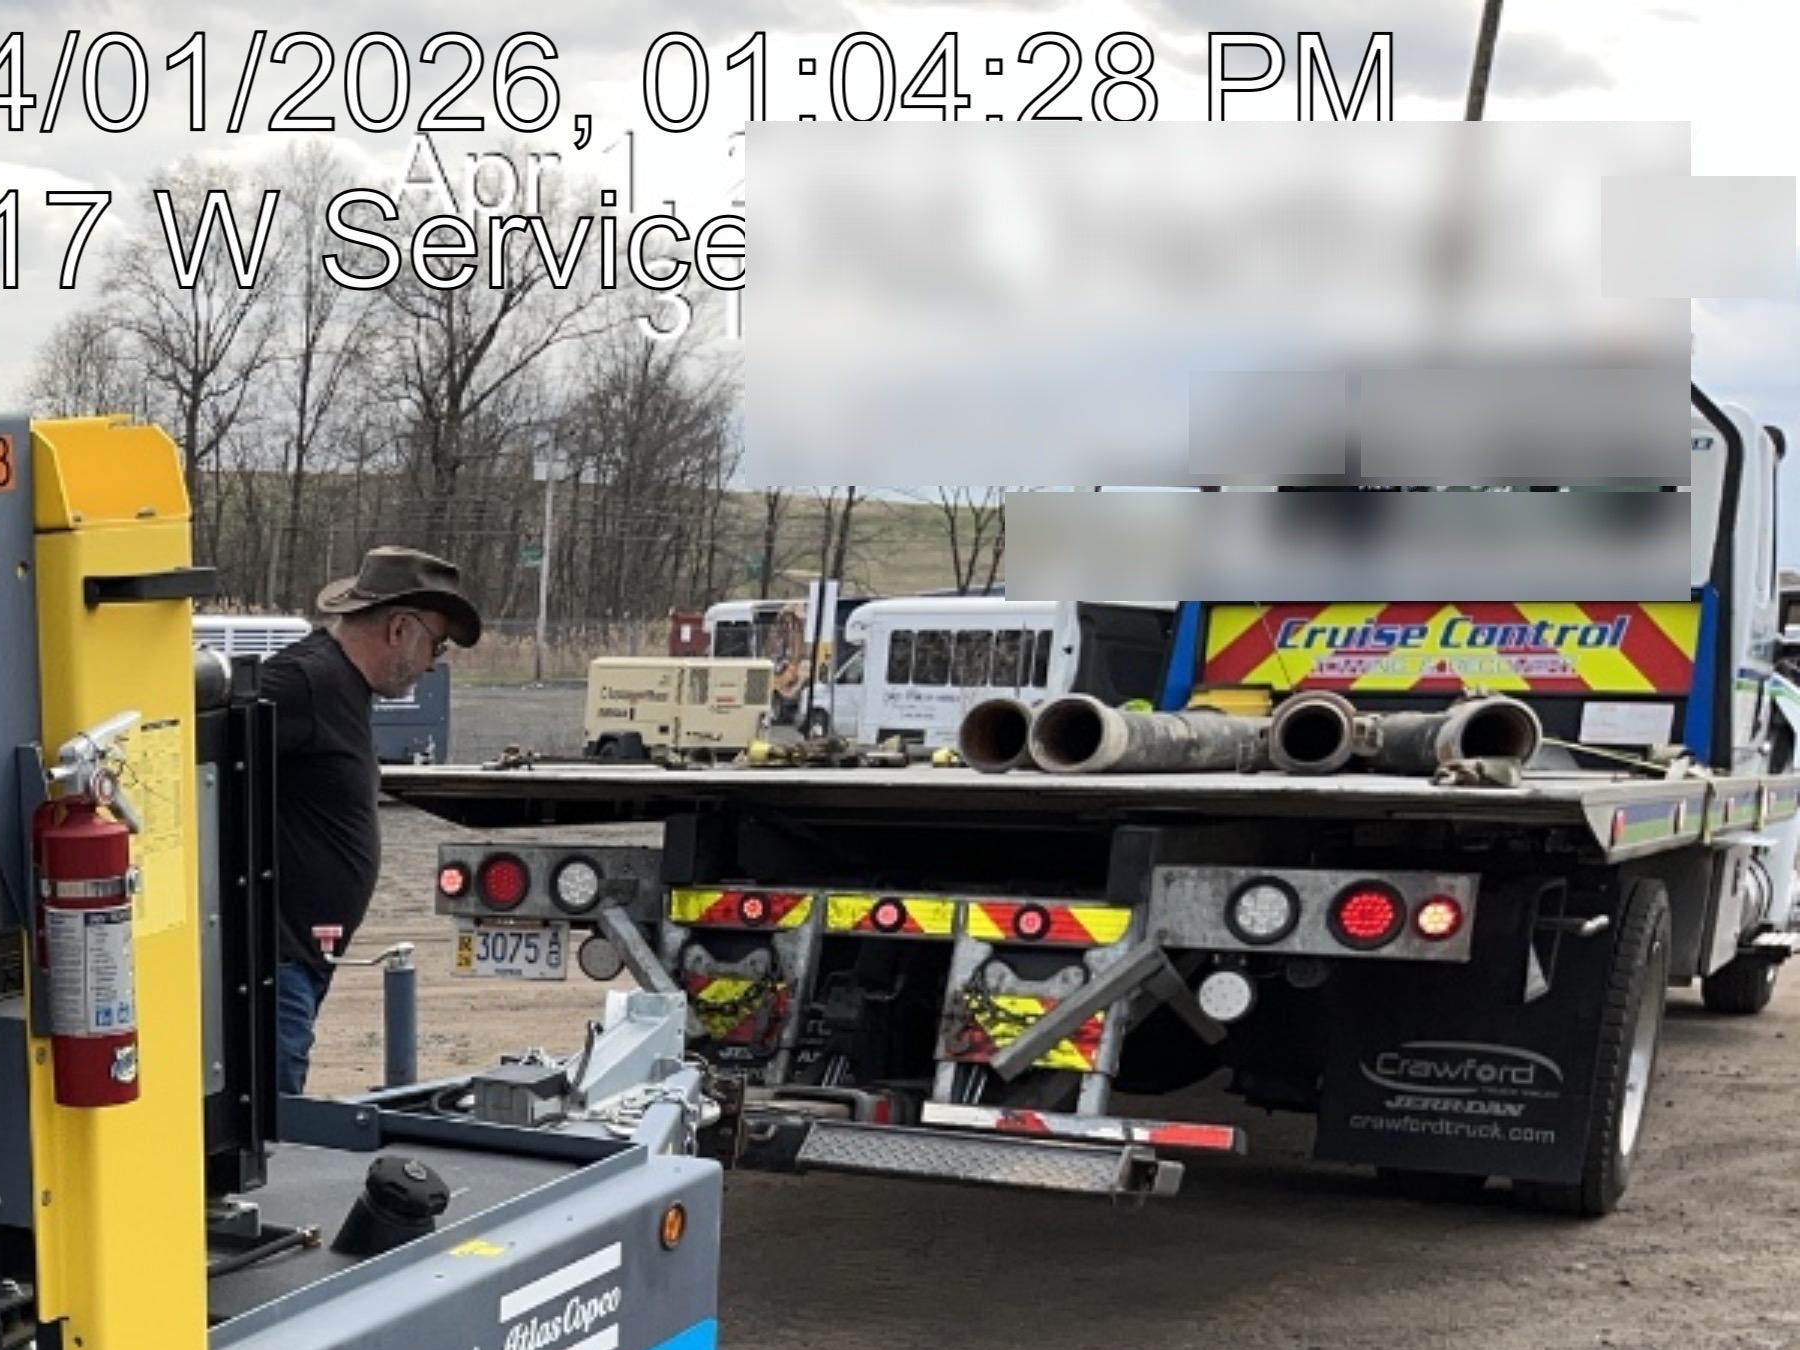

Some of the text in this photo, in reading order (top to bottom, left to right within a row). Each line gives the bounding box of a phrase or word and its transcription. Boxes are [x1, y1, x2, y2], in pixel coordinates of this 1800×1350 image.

[1276, 614, 1631, 650] Cruise Control
[476, 932, 541, 965] 3075
[1376, 1052, 1535, 1084] Crawford
[1350, 1115, 1556, 1144] crawfordtruck.com
